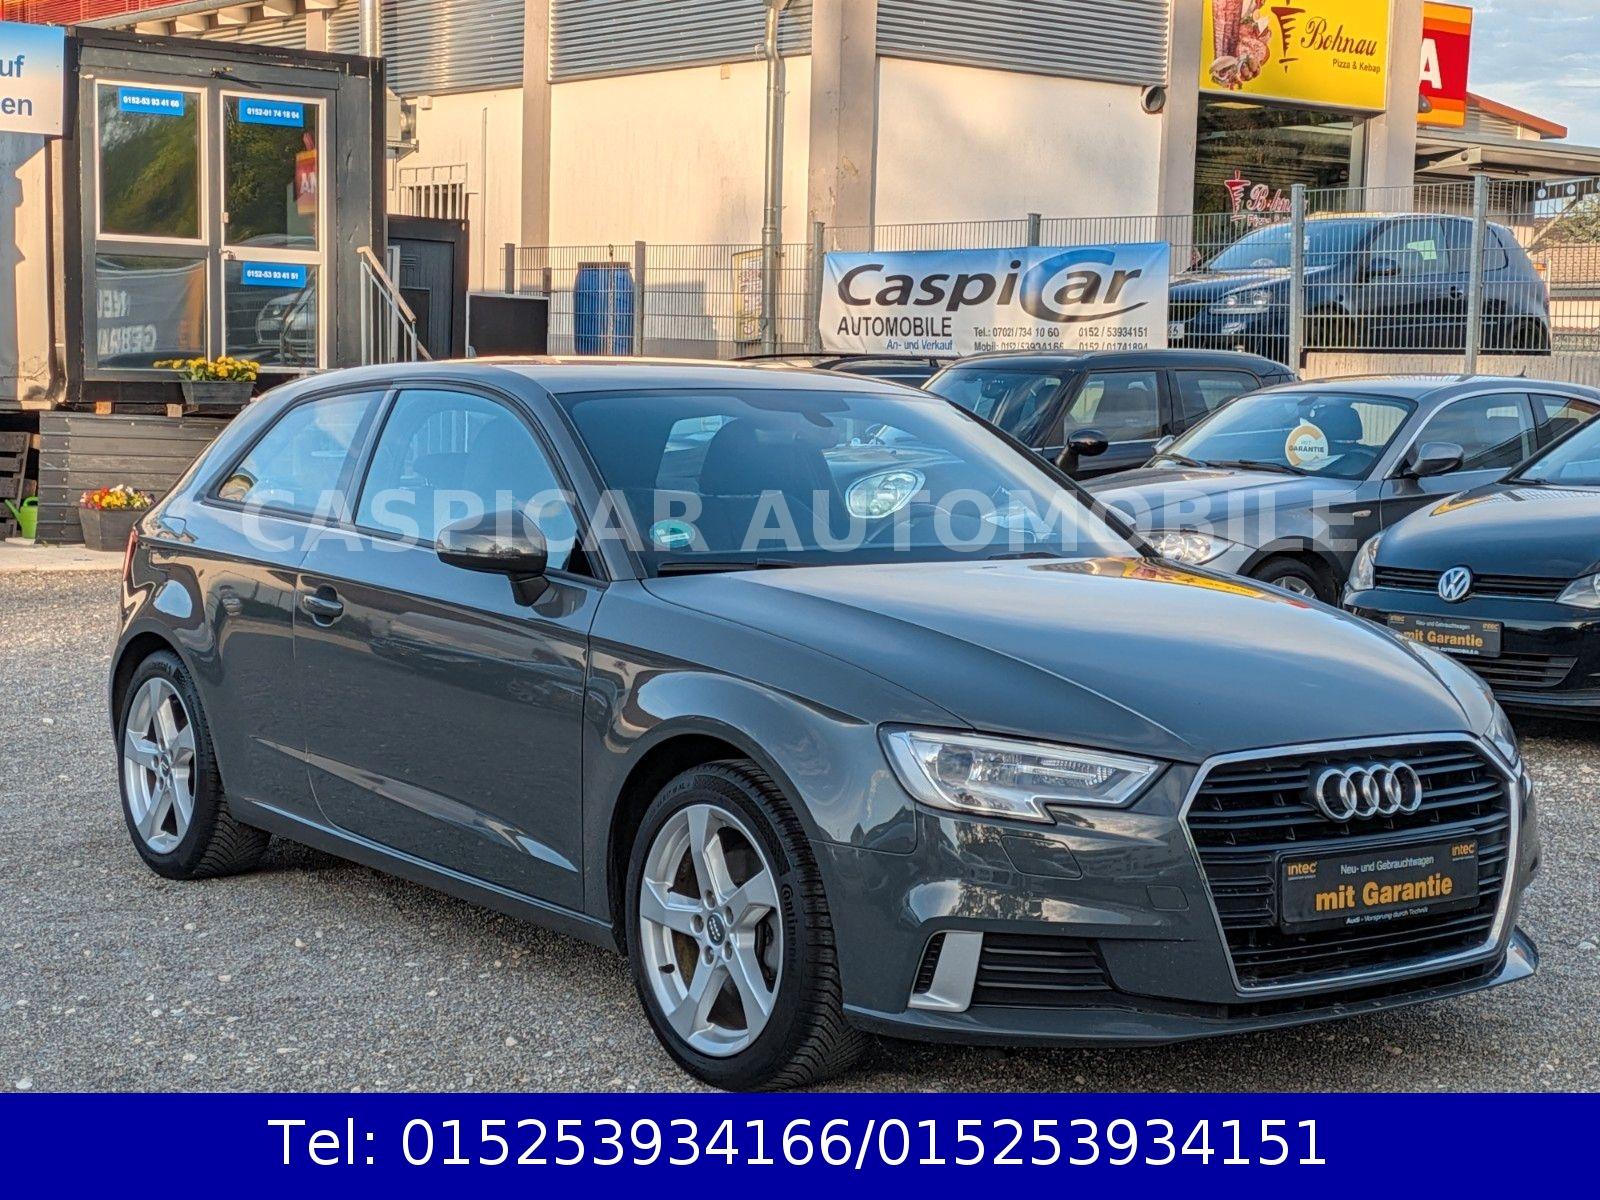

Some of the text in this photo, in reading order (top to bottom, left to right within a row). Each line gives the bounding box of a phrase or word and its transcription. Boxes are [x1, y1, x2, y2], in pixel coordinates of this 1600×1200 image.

[1301, 16, 1377, 56] Bohnau
[1332, 58, 1381, 74] Pizza & Kebap
[838, 249, 1149, 323] CaspiCar
[837, 316, 952, 337] AUTOMOBILE
[973, 326, 991, 337] Tel.:
[1035, 327, 1045, 337] 10
[1047, 327, 1060, 337] 60
[1107, 326, 1148, 338] 53934151
[886, 339, 953, 351] An- und Verkauf
[974, 341, 999, 351] Mobil:
[1288, 445, 1325, 453] GARANTIE
[1427, 630, 1484, 647] Garantie
[1452, 841, 1475, 857] intec
[1288, 861, 1317, 876] intec
[1340, 856, 1434, 875] Neu- und Gebrauchtwagen
[1315, 873, 1452, 911] mit Garantie
[1345, 916, 1361, 925] Audi
